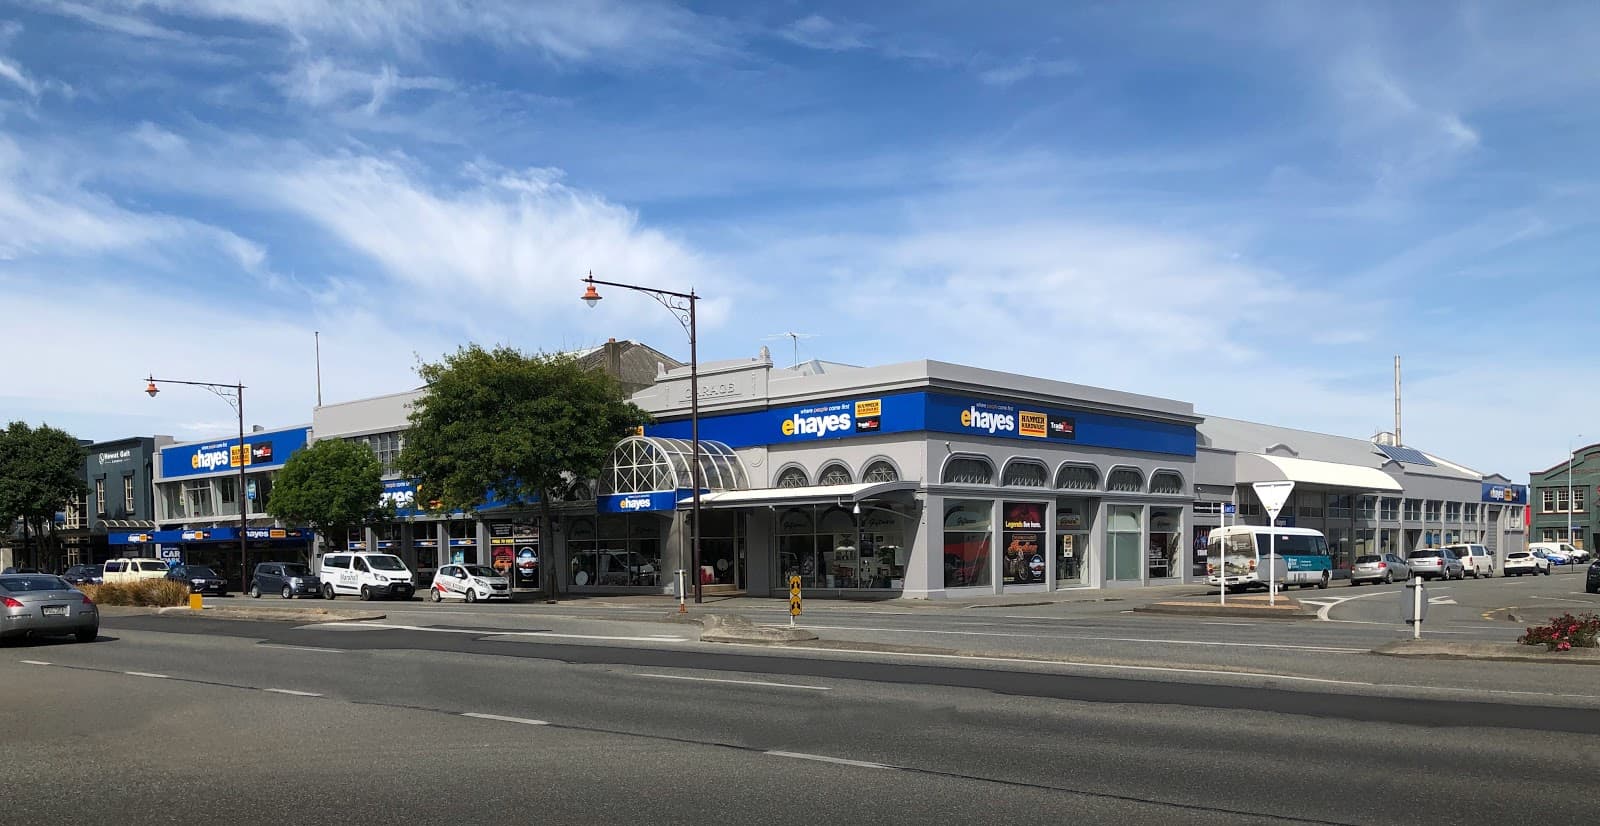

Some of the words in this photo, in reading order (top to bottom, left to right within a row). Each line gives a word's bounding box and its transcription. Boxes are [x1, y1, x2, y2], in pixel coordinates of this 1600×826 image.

[781, 412, 852, 437] ehayes
[961, 406, 1015, 434] ehayes
[1021, 414, 1045, 424] HAMMER
[191, 449, 229, 471] ehayes
[620, 497, 651, 511] ehayes
[162, 550, 181, 558] CAR
